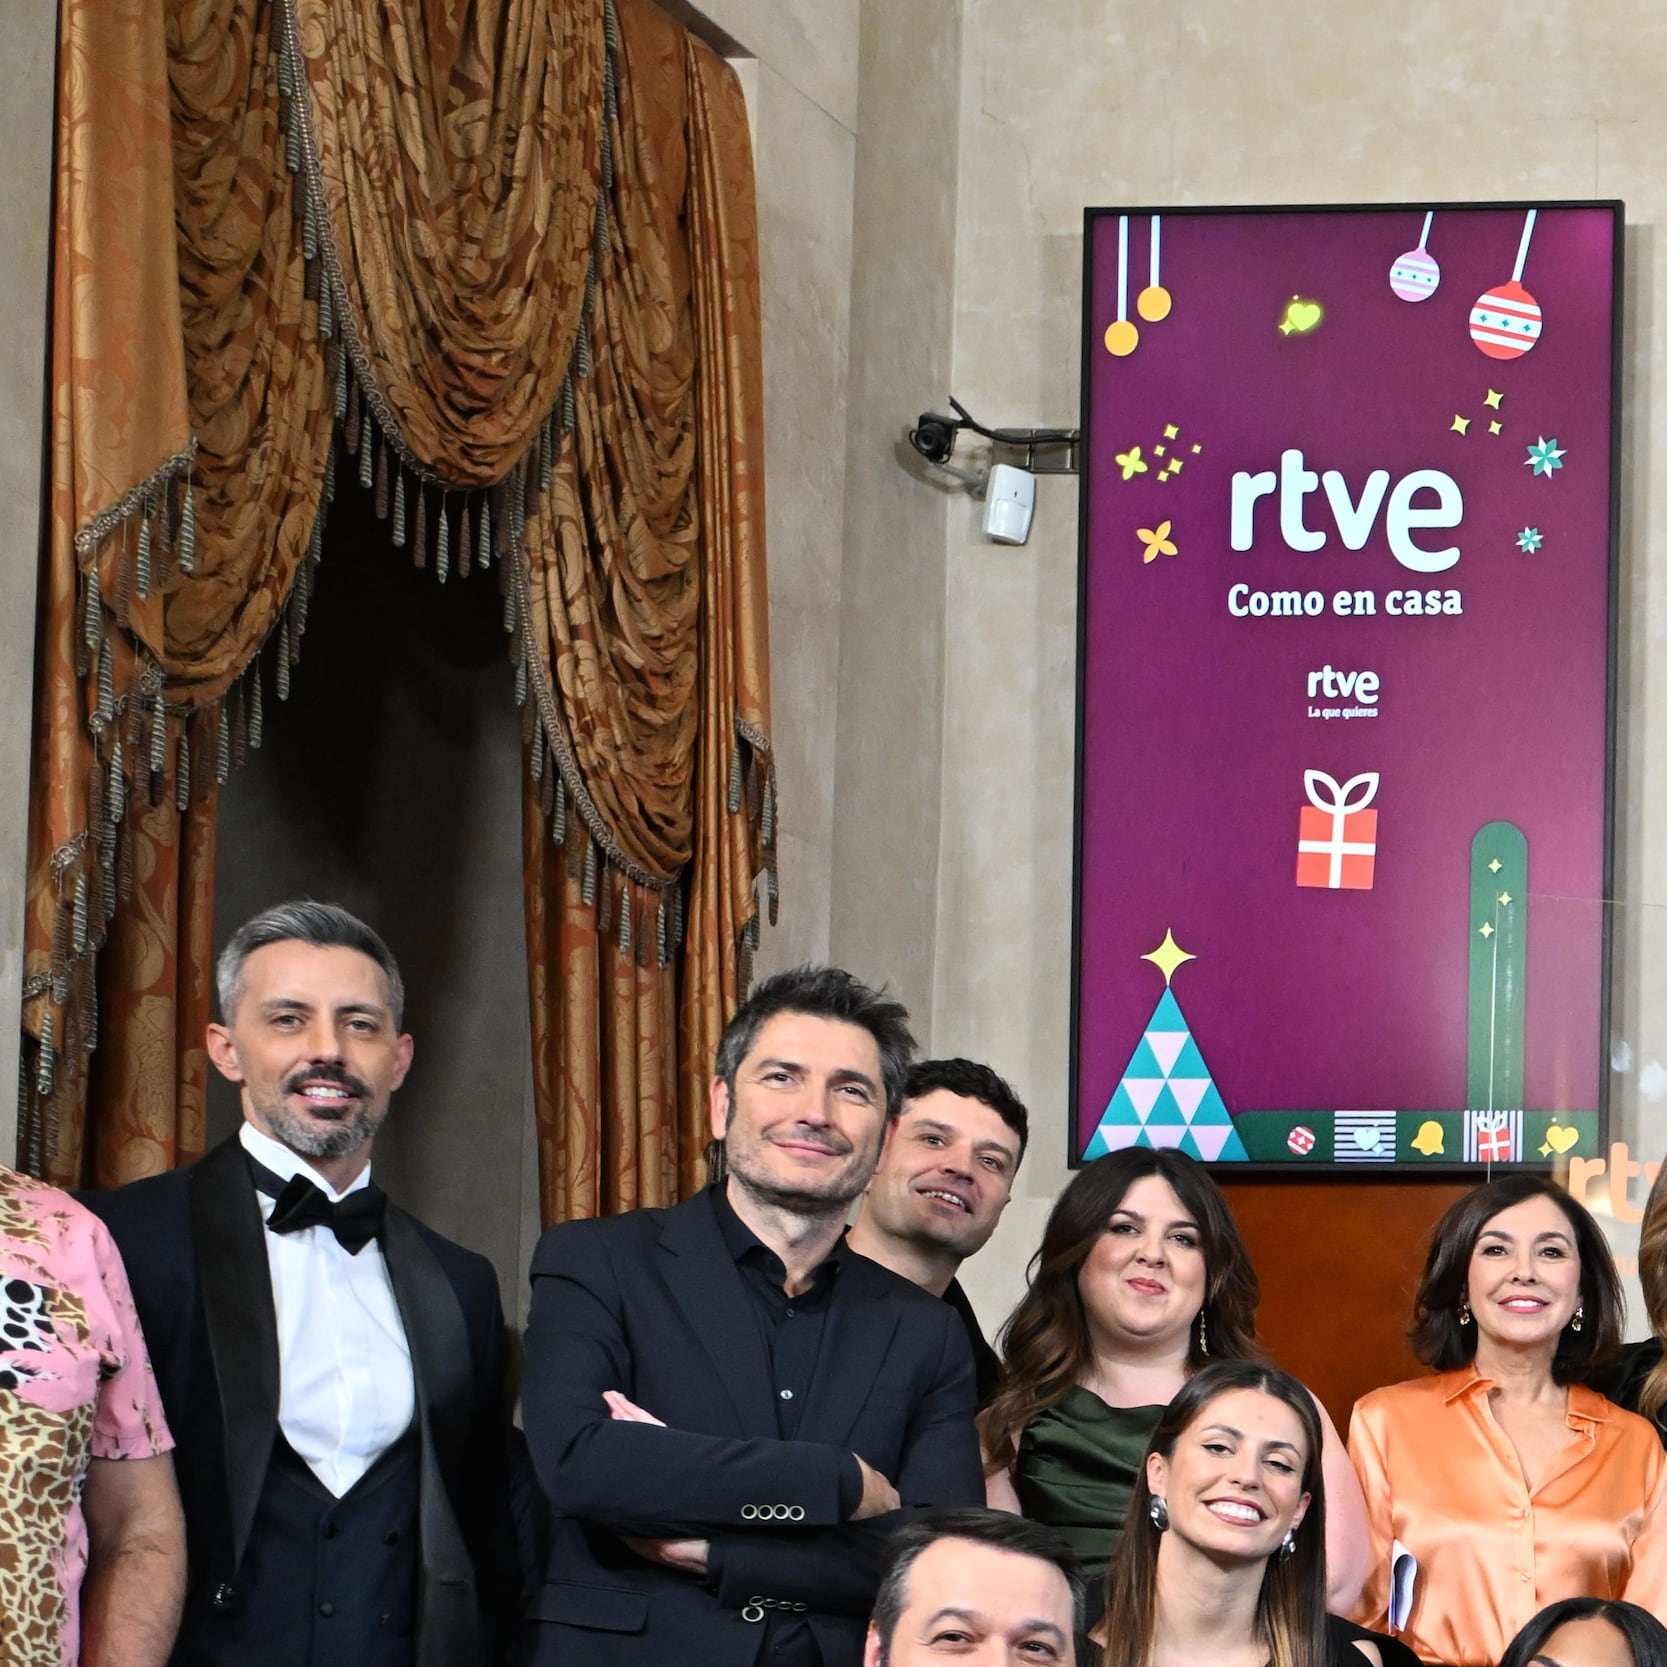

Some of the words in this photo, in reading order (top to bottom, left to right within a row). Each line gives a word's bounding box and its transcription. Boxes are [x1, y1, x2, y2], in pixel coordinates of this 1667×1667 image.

[1231, 448, 1464, 573] rtve
[1228, 583, 1325, 617] Como
[1333, 590, 1377, 616] en
[1385, 589, 1464, 616] casa
[1307, 664, 1380, 704] rtve
[1308, 705, 1321, 718] La
[1322, 707, 1341, 720] que
[1342, 705, 1379, 720] quieres
